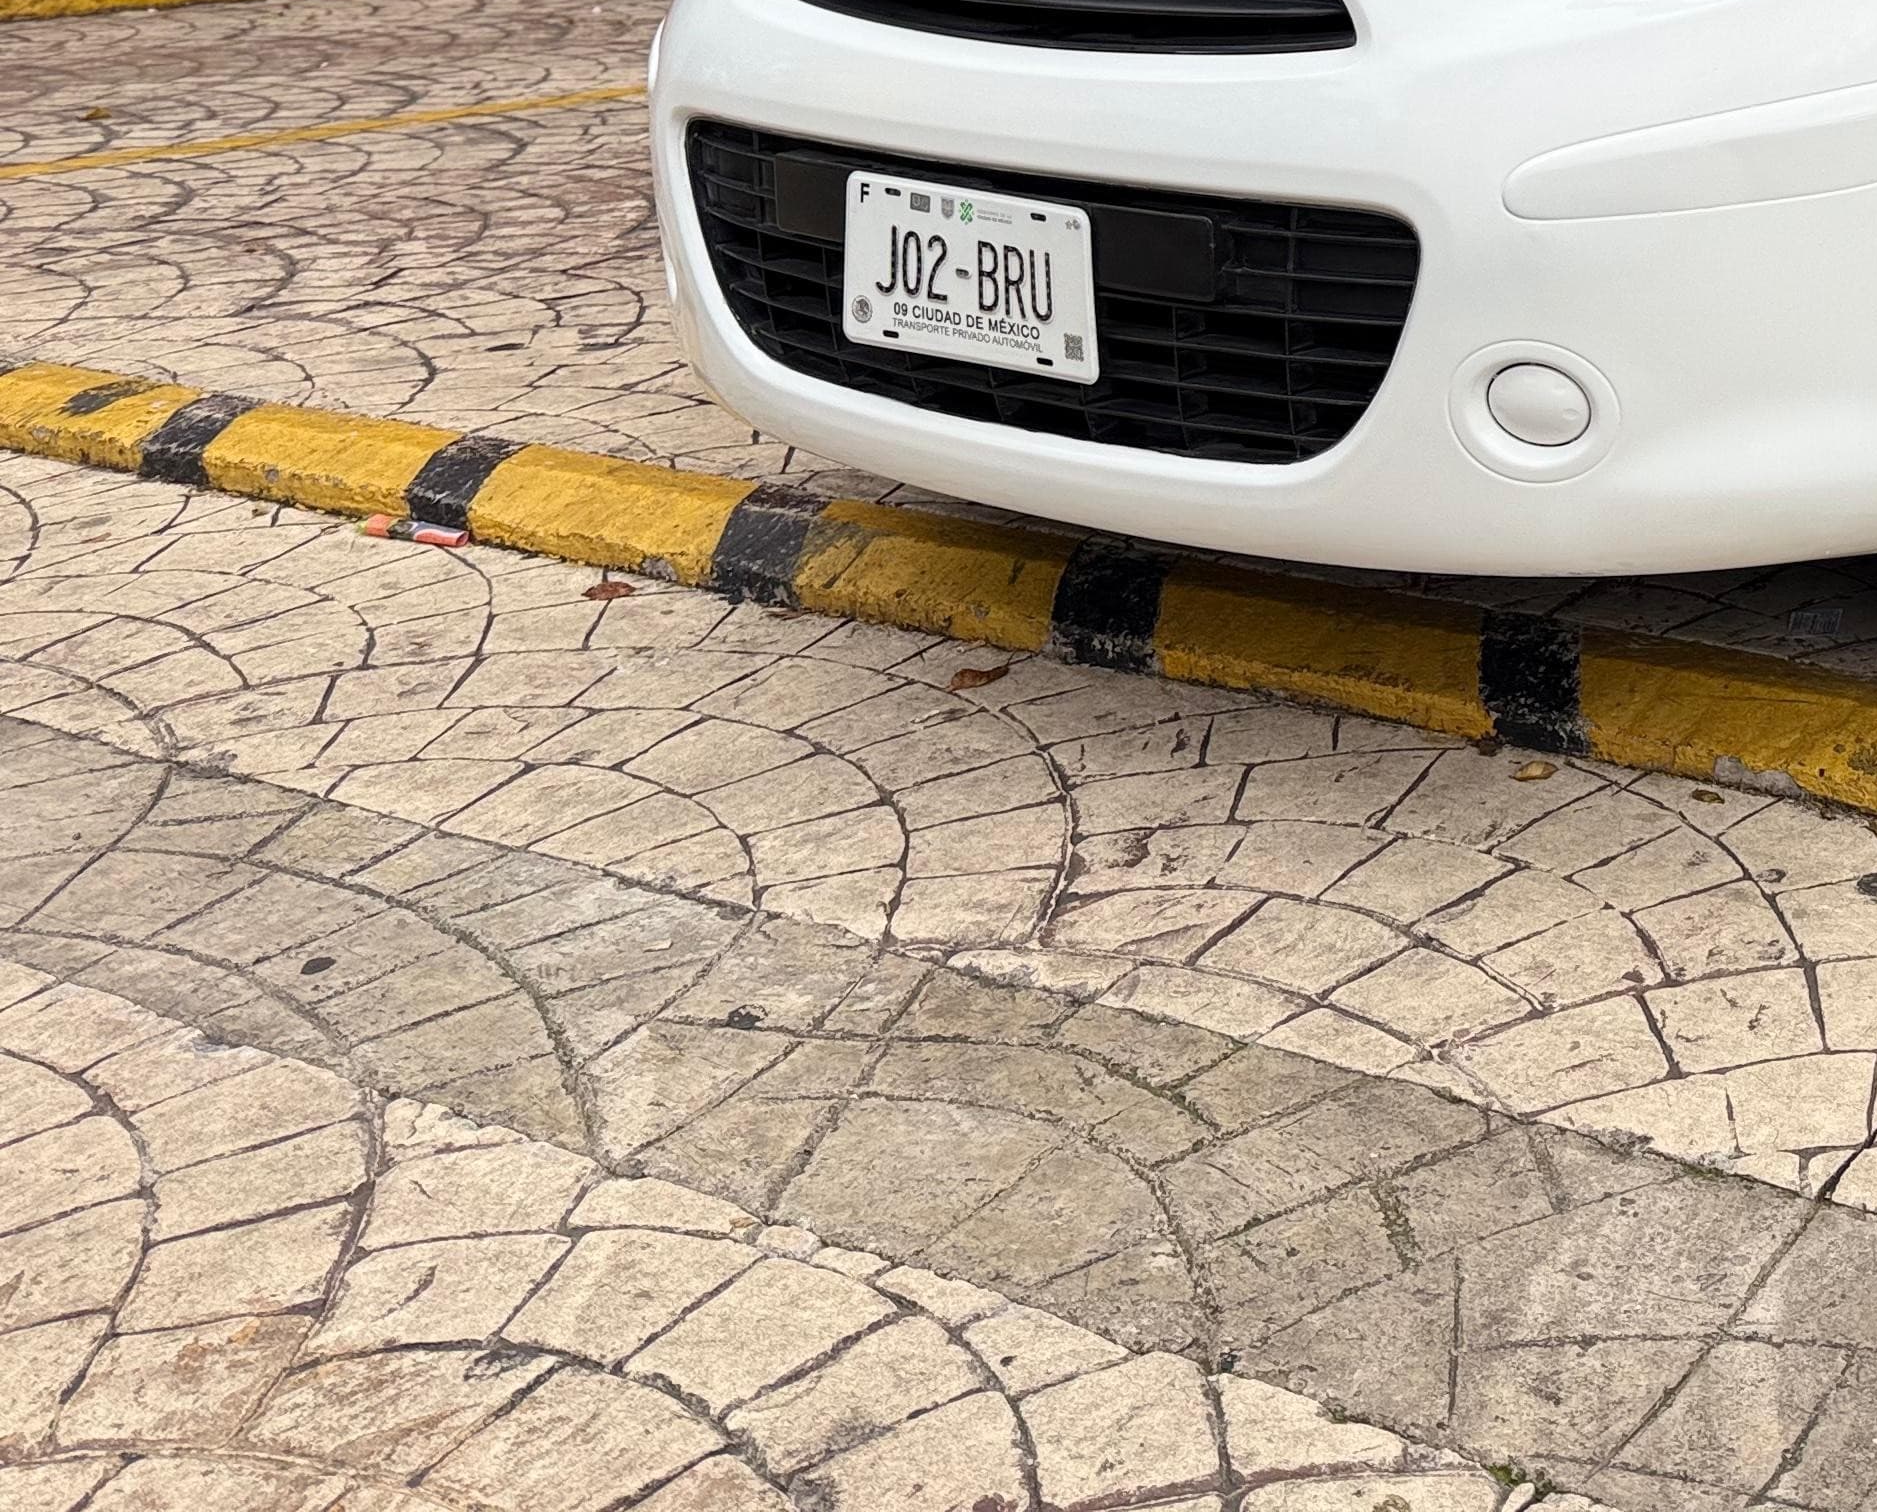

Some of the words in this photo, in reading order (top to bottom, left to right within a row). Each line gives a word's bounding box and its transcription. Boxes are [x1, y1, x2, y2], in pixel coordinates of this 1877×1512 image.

[860, 182, 871, 203] F
[875, 224, 1052, 323] J02-BRU
[891, 317, 951, 337] TRANSPORTE
[952, 328, 991, 345] PRIVADO
[893, 301, 908, 317] 09
[912, 305, 962, 327] CIUDAD
[966, 314, 985, 330] DE
[988, 316, 1041, 340] MÉXICO
